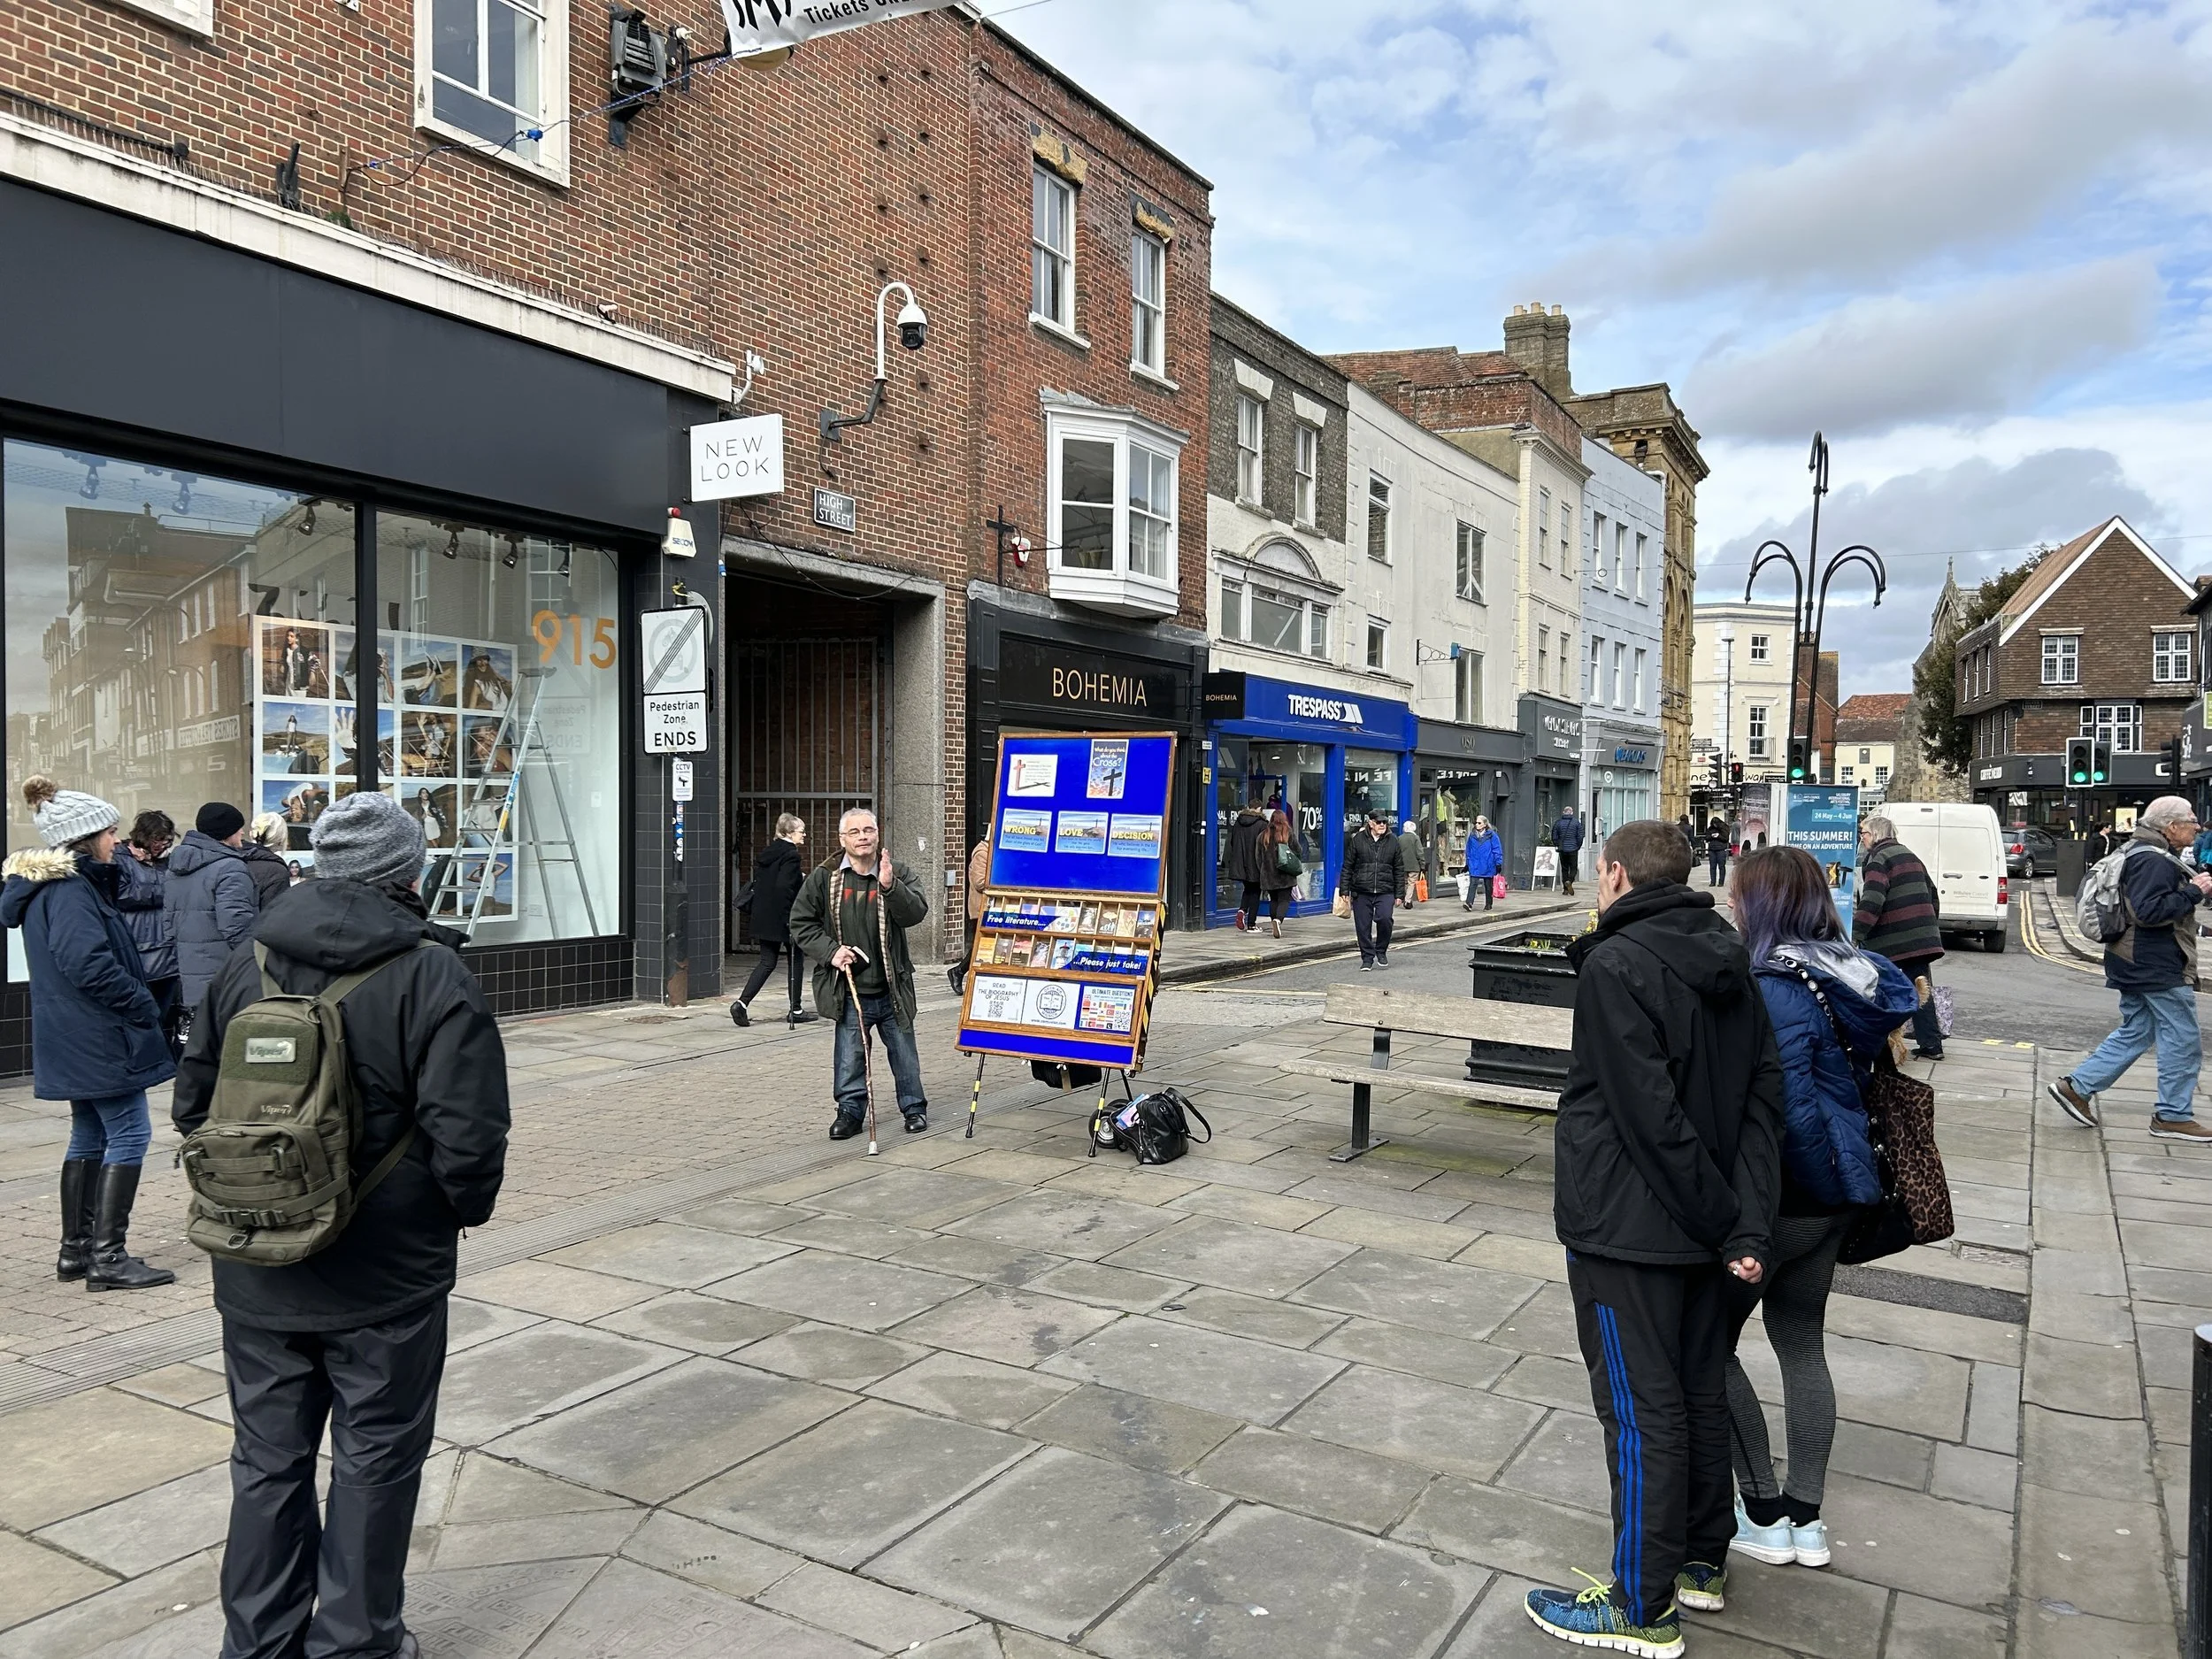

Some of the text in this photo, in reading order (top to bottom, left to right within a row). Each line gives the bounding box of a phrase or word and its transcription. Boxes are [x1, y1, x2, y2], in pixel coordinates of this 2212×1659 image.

[803, 0, 870, 24] Tickets
[706, 435, 763, 459] NEW
[702, 457, 769, 482] LOOK
[818, 494, 843, 511] HIGH
[818, 508, 852, 526] STREET
[672, 536, 694, 548] SECOM
[533, 610, 617, 670] 915
[1052, 667, 1148, 707] BOHEMIA
[649, 700, 700, 712] Pedestrian
[1287, 694, 1343, 722] TRESPASS
[664, 714, 687, 724] Zone
[654, 731, 697, 747] ENDS
[1093, 757, 1122, 767] Cross?
[1004, 825, 1037, 835] WRONG
[1059, 828, 1084, 837] LOVE
[1787, 831, 1853, 841] THIS SUMMER!
[1112, 832, 1154, 841] DECISION
[987, 913, 1003, 924] Free
[1105, 958, 1121, 969] just
[1122, 959, 1141, 971] take!
[987, 988, 1019, 997] BIOGRAPHY
[249, 1045, 288, 1057] Viper
[260, 1105, 290, 1115] Viper
